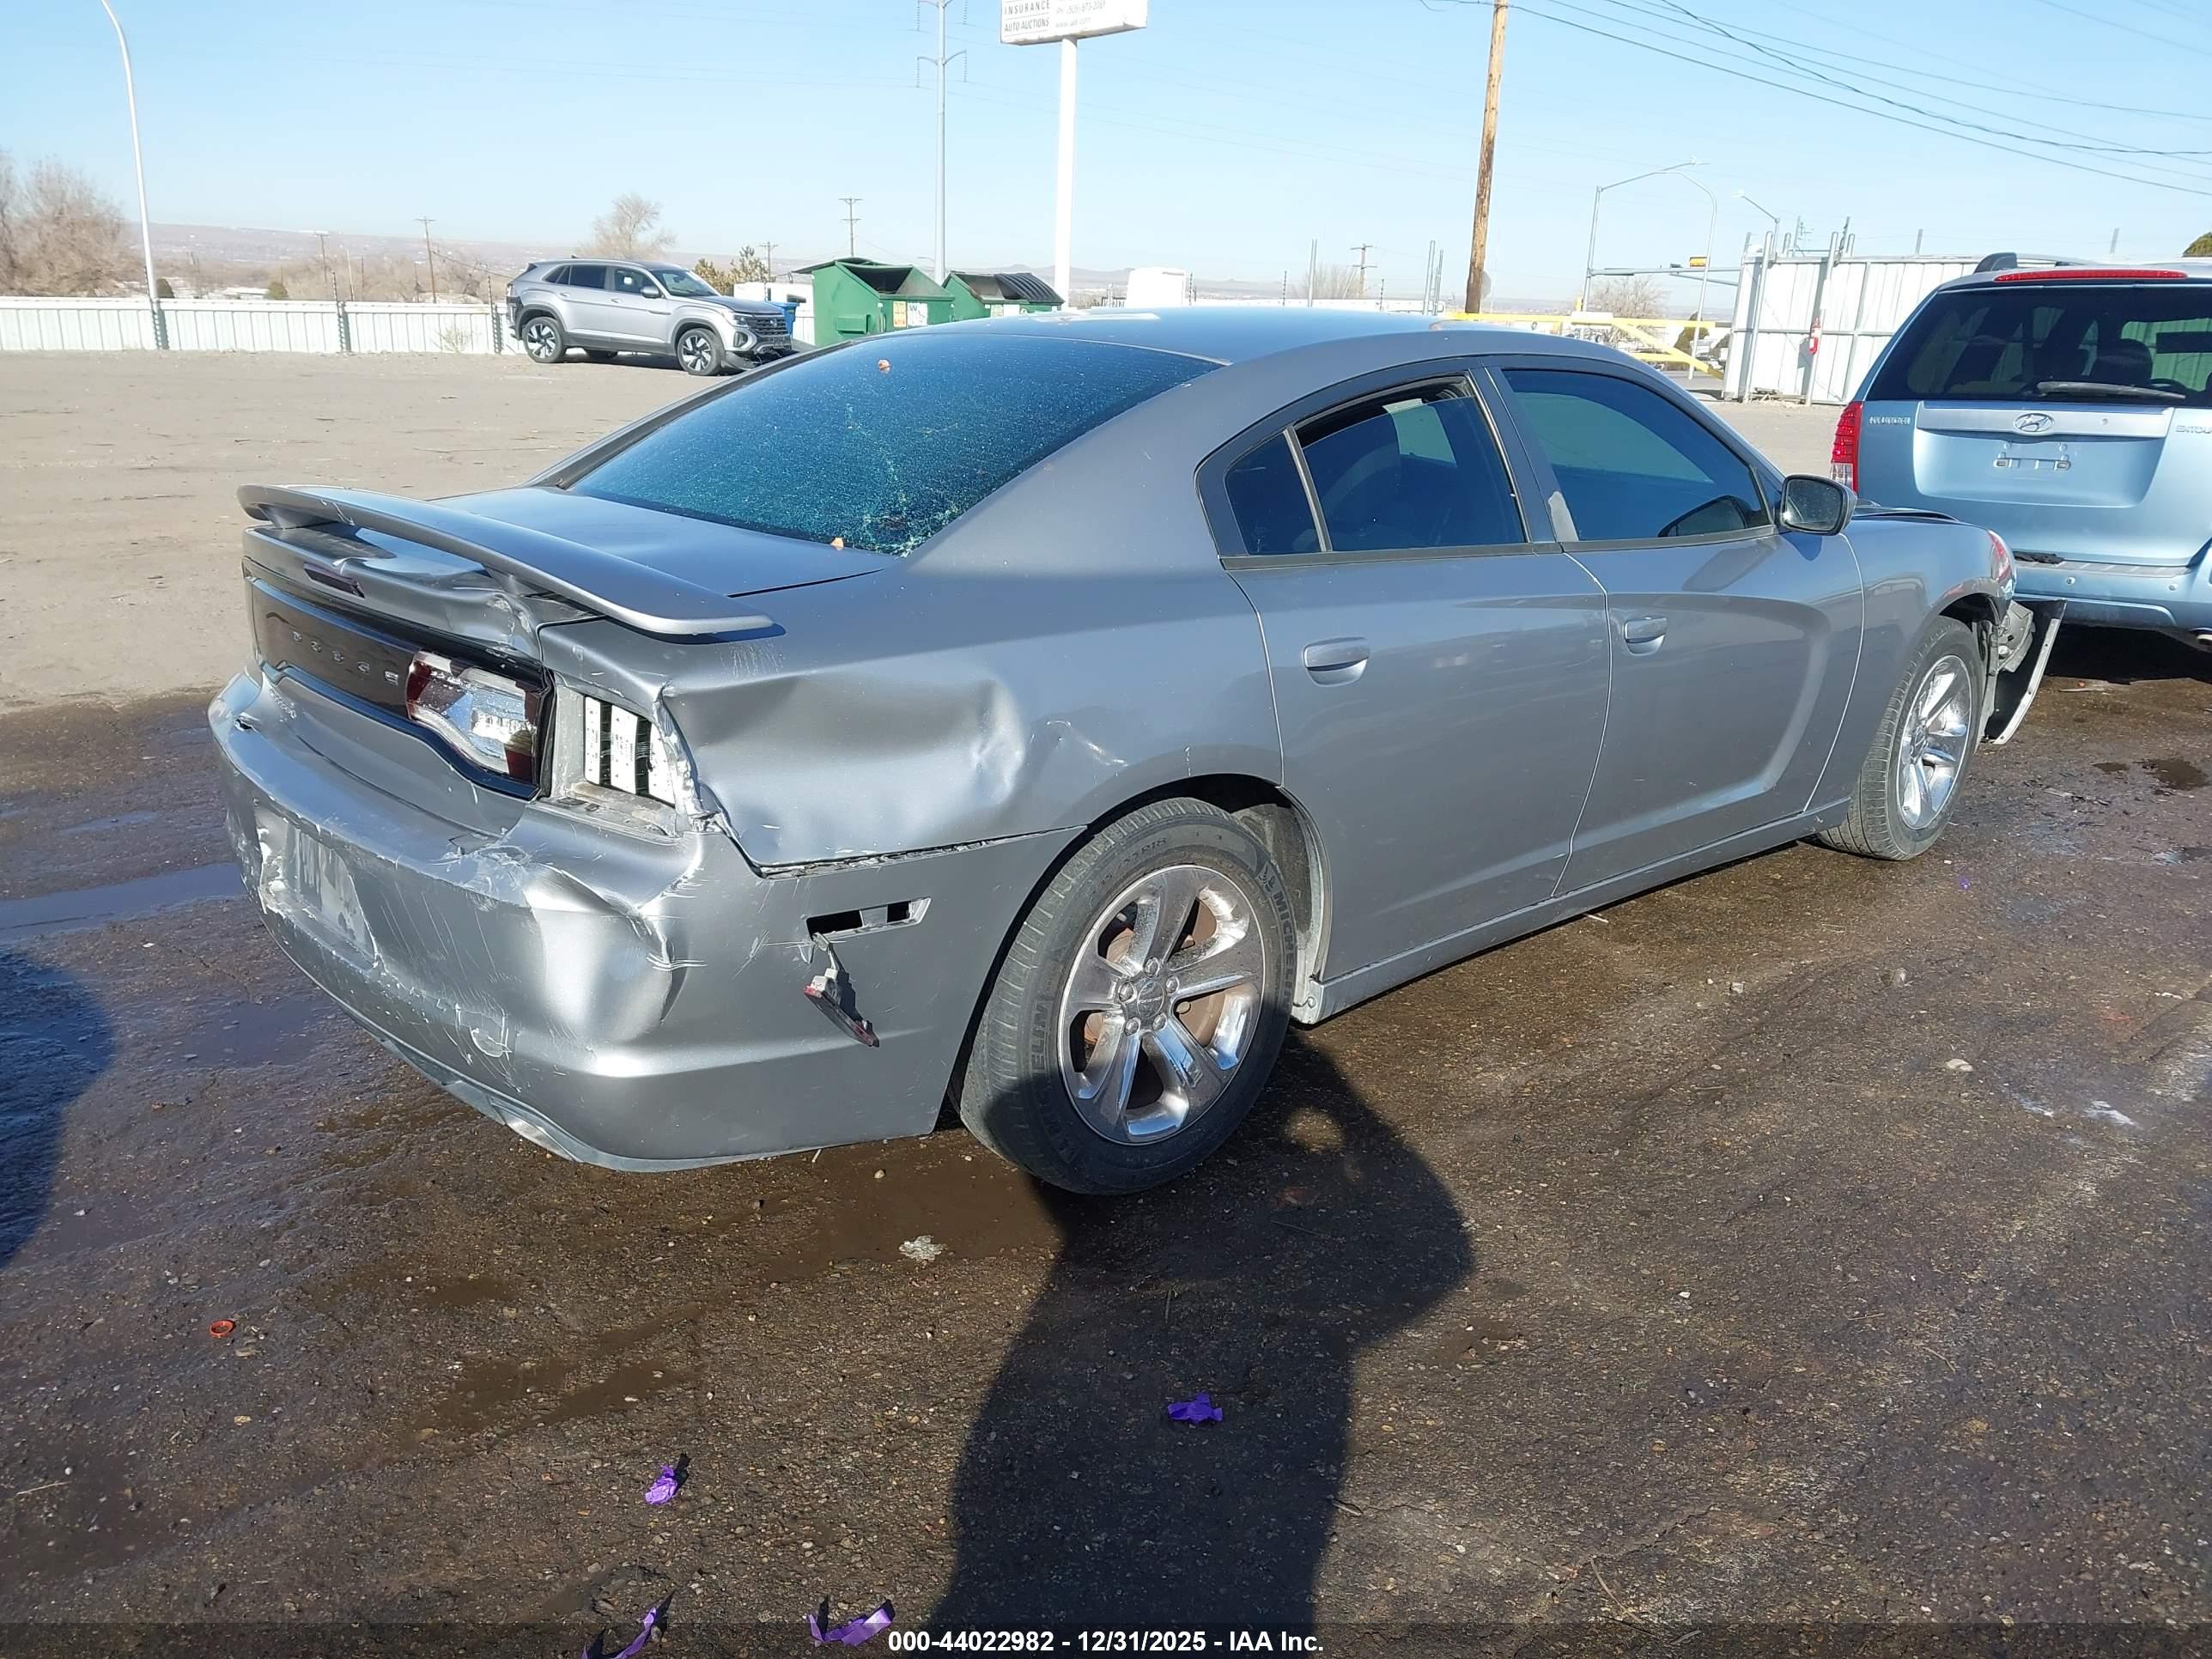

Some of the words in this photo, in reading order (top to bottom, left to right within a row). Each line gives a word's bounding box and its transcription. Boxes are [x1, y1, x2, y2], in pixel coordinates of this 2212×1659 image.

[1005, 0, 1049, 15] INSURANCE
[1005, 21, 1020, 32] AUTO
[1021, 17, 1049, 29] AUCTIONS
[2176, 425, 2212, 434] ENTOU
[1273, 890, 1295, 1012] MICHELIN
